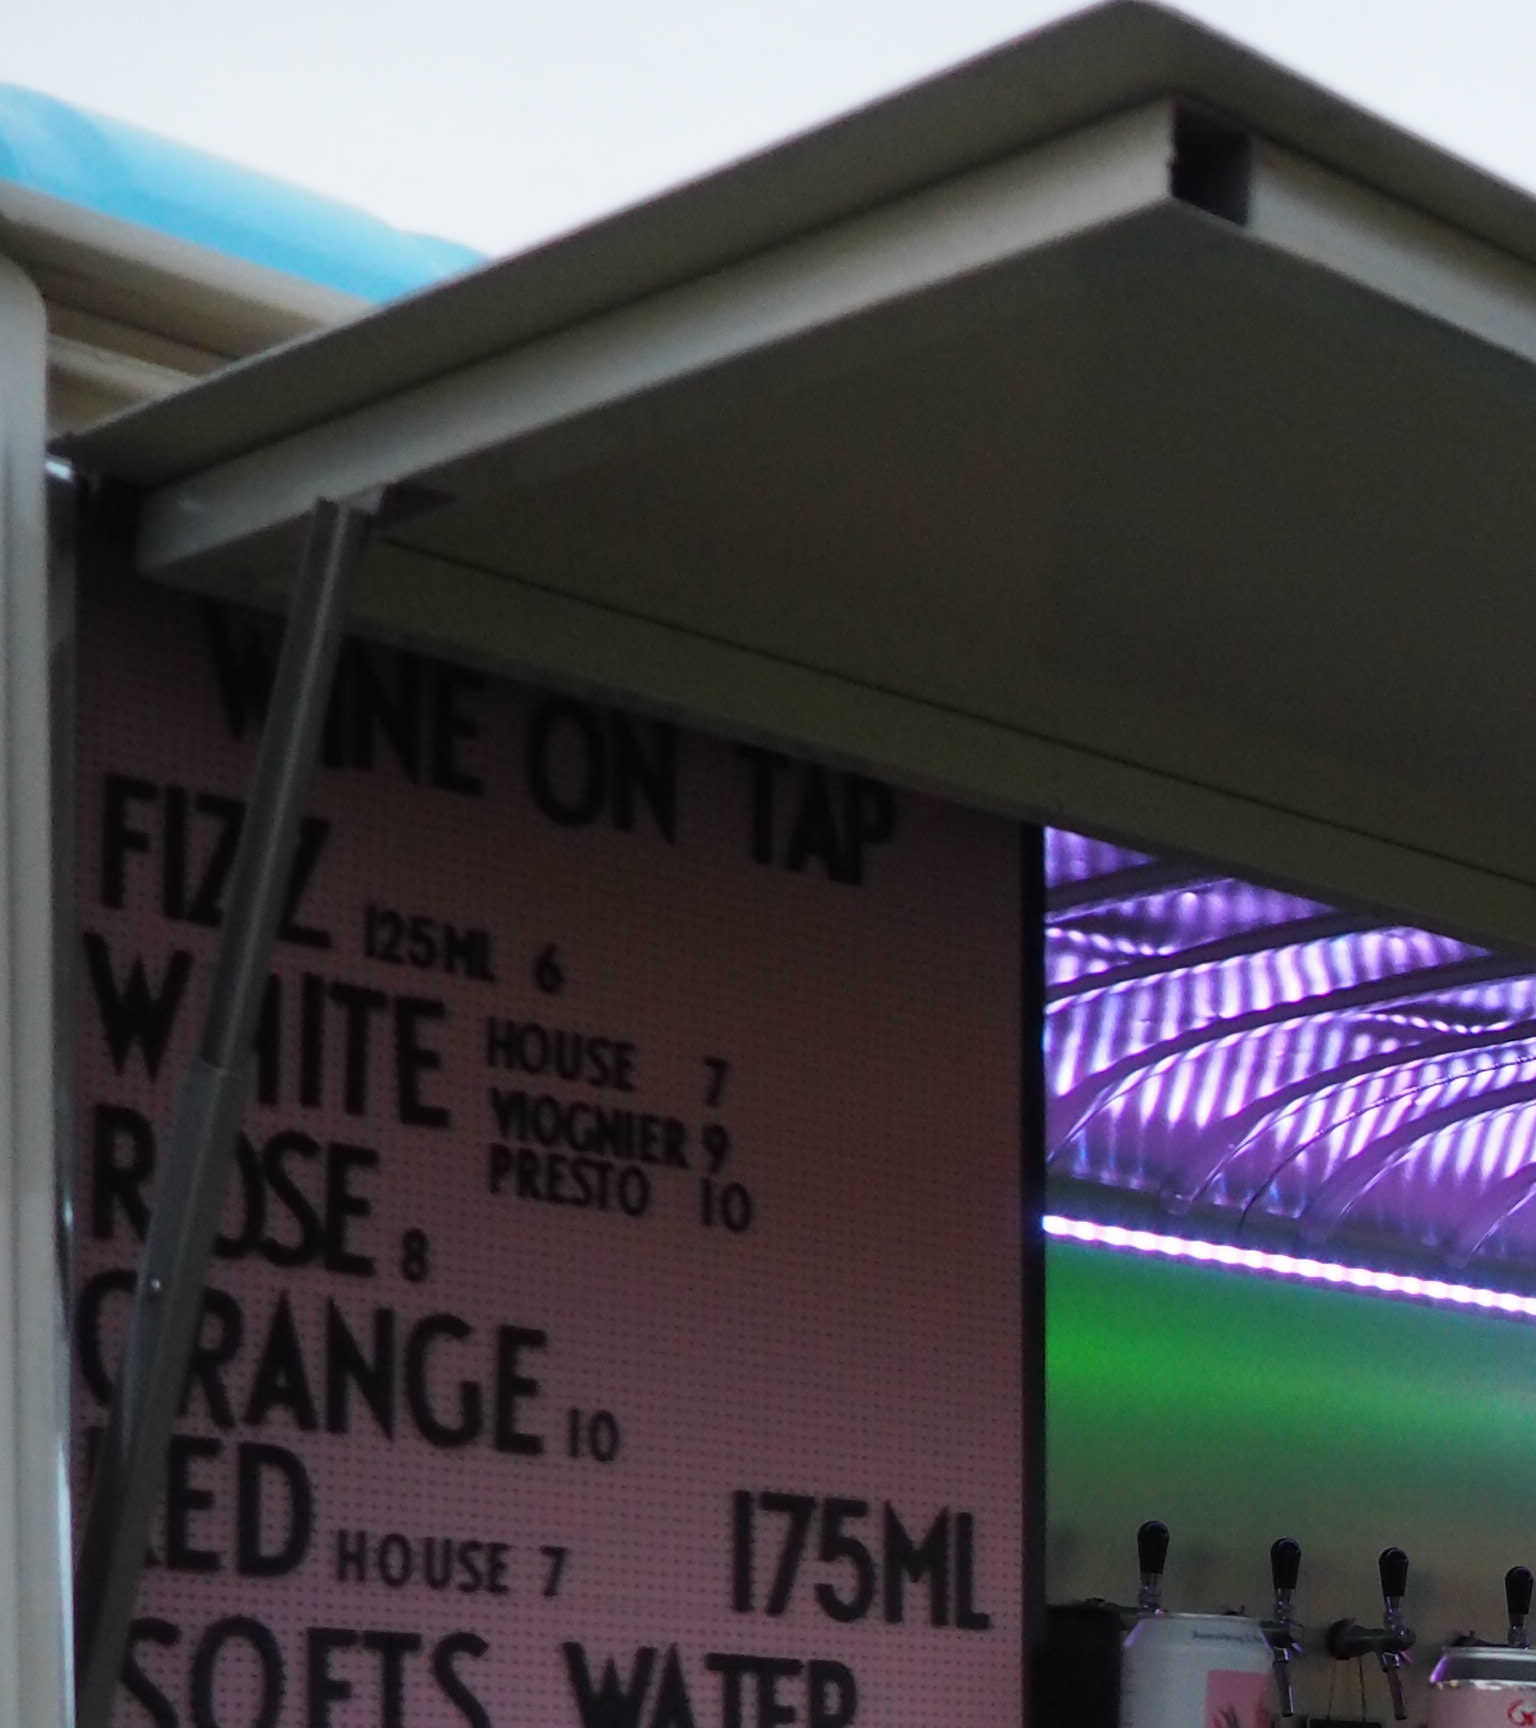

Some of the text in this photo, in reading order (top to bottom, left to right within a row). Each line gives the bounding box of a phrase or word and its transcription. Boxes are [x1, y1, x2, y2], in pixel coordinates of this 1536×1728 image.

[528, 695, 677, 846] ON
[734, 744, 898, 886] TAP
[365, 903, 495, 984] 125ML
[534, 942, 564, 995] 6
[487, 1015, 637, 1093] HOUSE
[702, 1054, 731, 1107] 7
[488, 1085, 730, 1175] VIOGNIER 9
[488, 1141, 754, 1234] PRESTO 10
[402, 1228, 430, 1284] 8
[567, 1406, 621, 1463] 10
[87, 1424, 568, 1598] ED HOUSE 7
[731, 1489, 992, 1631] 175ML
